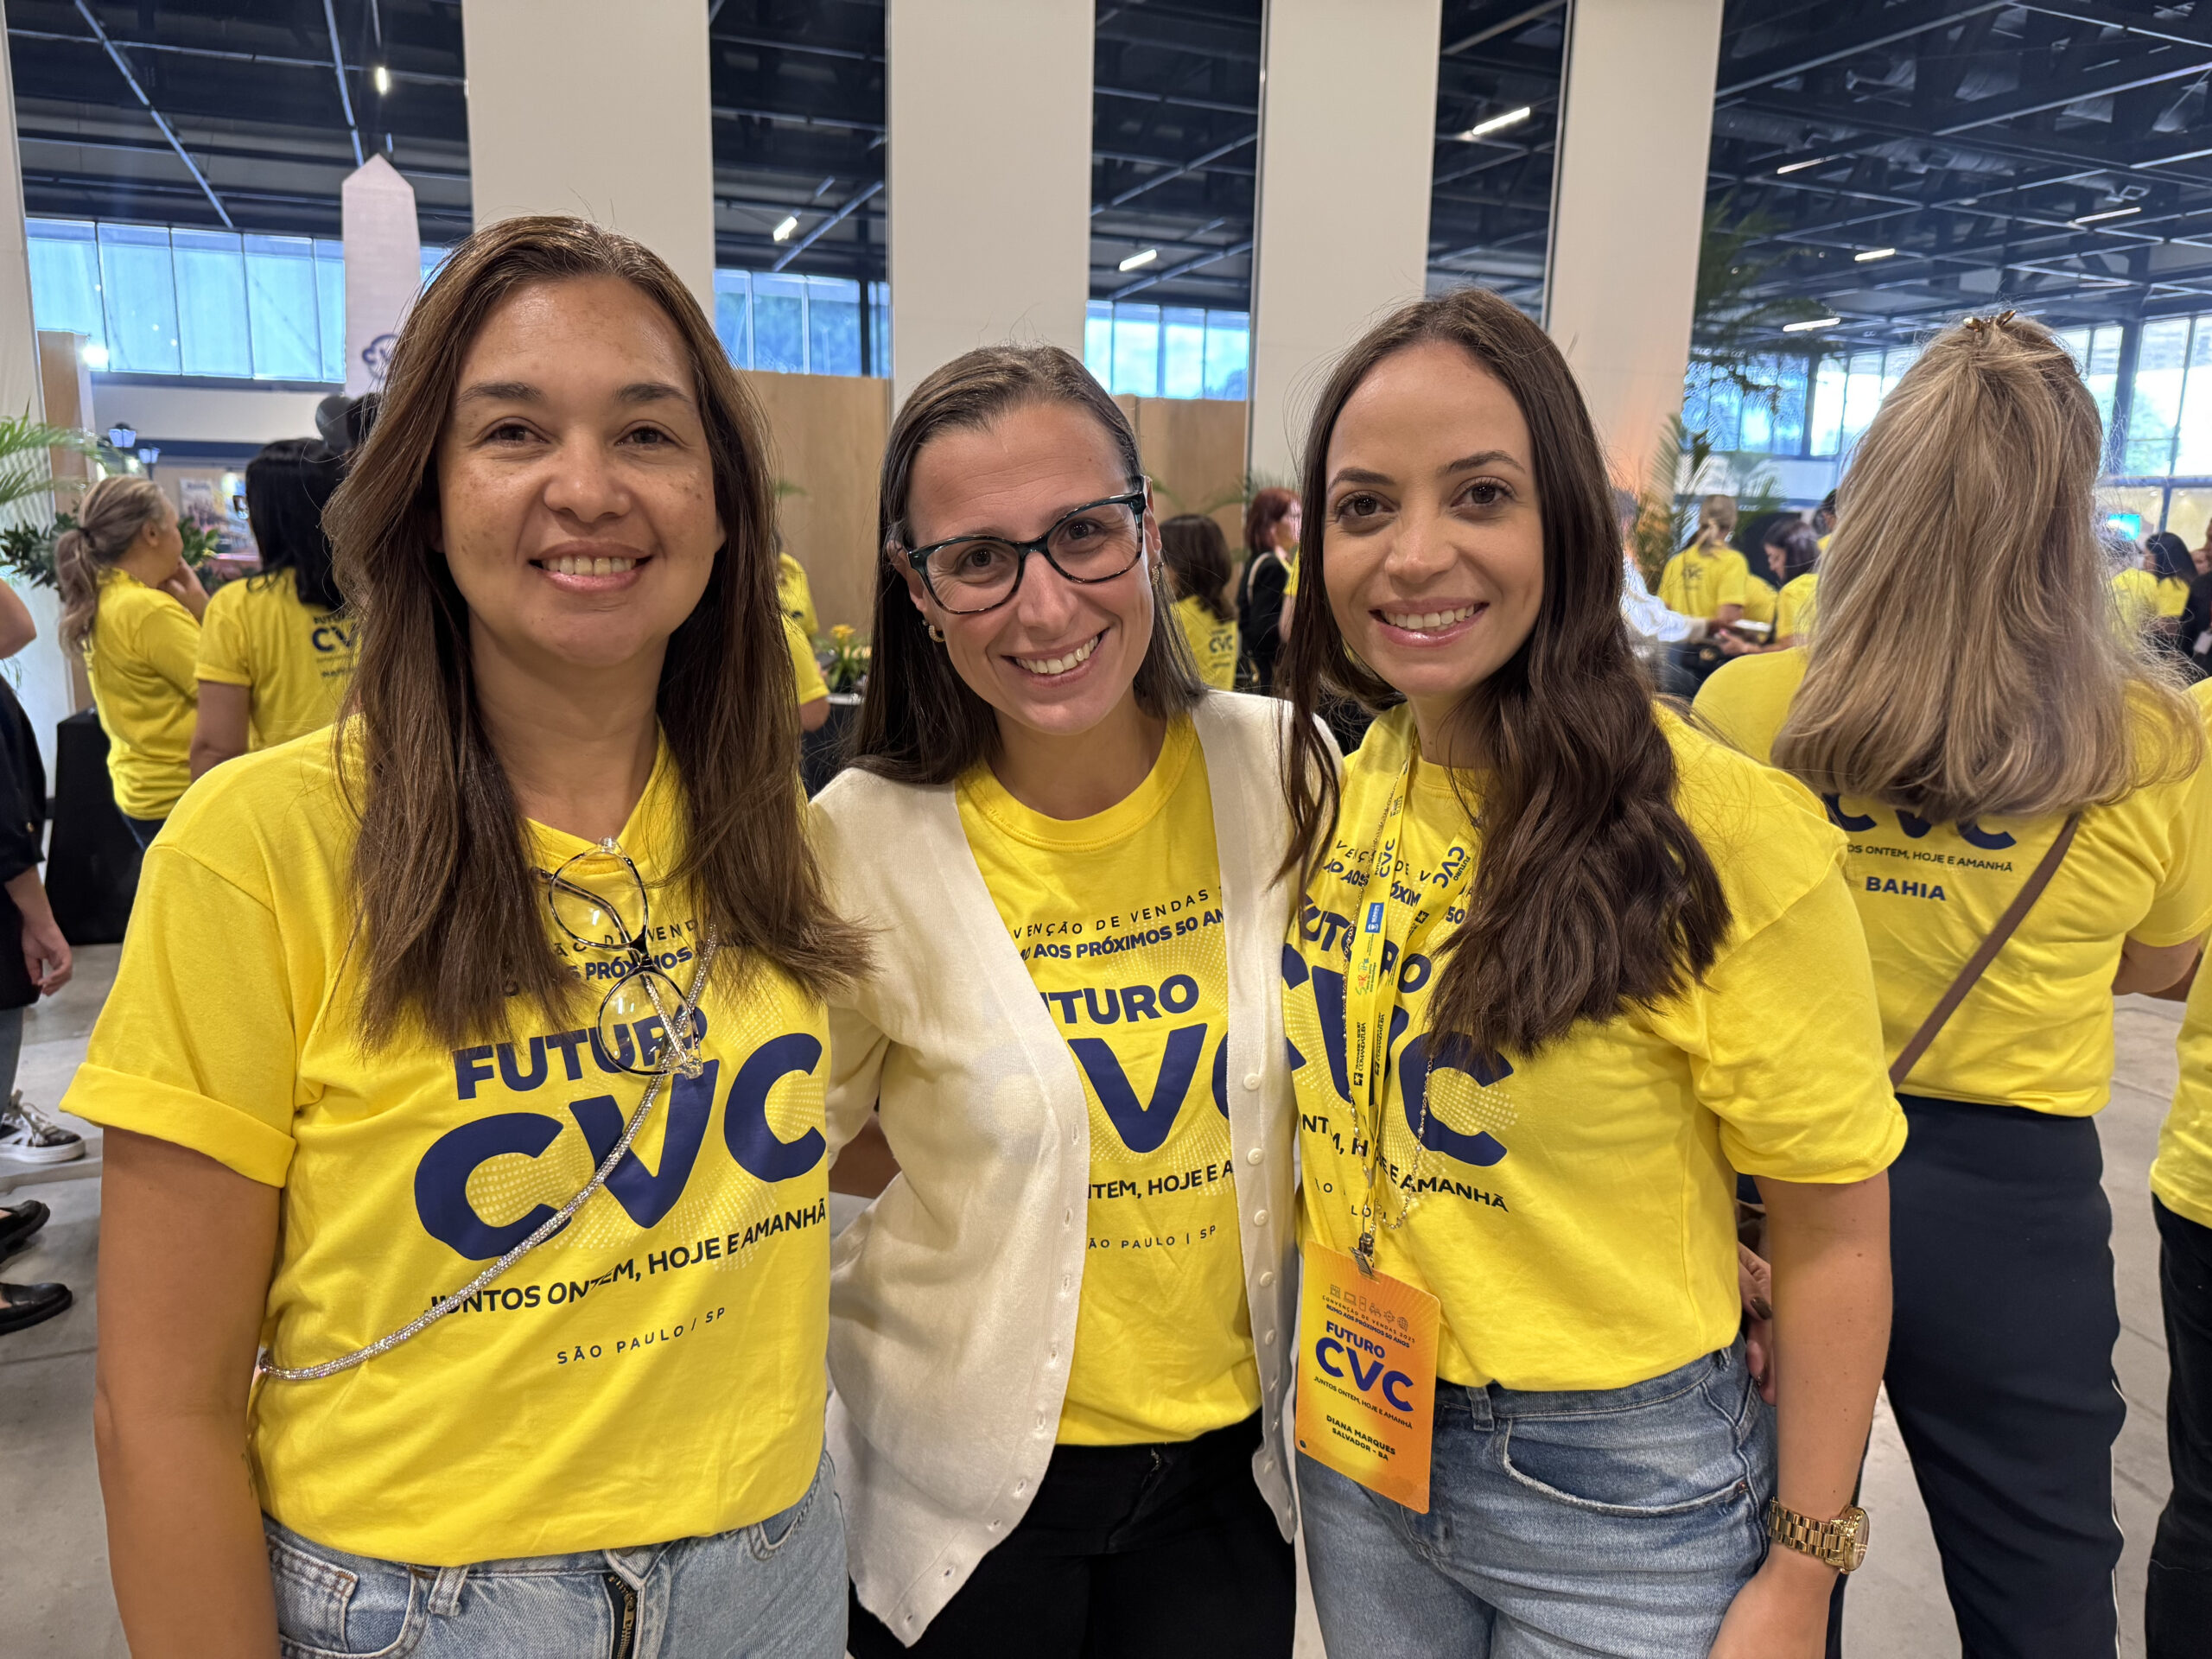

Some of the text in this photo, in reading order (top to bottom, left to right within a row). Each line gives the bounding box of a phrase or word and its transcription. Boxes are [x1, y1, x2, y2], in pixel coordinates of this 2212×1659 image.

[312, 627, 355, 652] CV
[1380, 838, 1395, 878] CVC
[1433, 846, 1465, 889] CVC
[1453, 855, 1471, 881] FUTURO
[1866, 845, 1910, 860] ONTEM,
[1913, 851, 1944, 864] HOJE
[1948, 856, 1955, 865] E
[1957, 857, 2012, 873] AMANHÃ
[1866, 876, 1946, 901] BAHIA
[648, 918, 698, 941] VEND
[1014, 921, 1083, 939] VENÇÃO
[1096, 916, 1120, 931] DE
[1130, 889, 1209, 923] VENDAS
[1446, 906, 1466, 925] 50
[1033, 943, 1071, 959] AOS
[1077, 925, 1173, 958] PRÓXIMOS
[1176, 917, 1198, 936] 50
[1040, 974, 1199, 1026] TURO
[415, 1033, 826, 1262] CVC
[1089, 1180, 1141, 1199] TEM,
[1148, 1169, 1202, 1196] HOJE
[1207, 1164, 1217, 1183] E
[1400, 1173, 1509, 1213] AMANHÃ
[648, 1236, 721, 1274] HOJE
[728, 1232, 740, 1255] E
[741, 1198, 826, 1249] AMANHÃ
[1089, 1237, 1110, 1249] ÃO
[1121, 1236, 1175, 1249] PAULO
[1200, 1224, 1216, 1239] SP
[556, 1345, 602, 1364] SÃO
[616, 1325, 683, 1353] PAULO
[705, 1307, 725, 1323] SP
[1326, 1304, 1343, 1315] RUMO
[1343, 1313, 1355, 1321] AOS
[1393, 1337, 1409, 1348] ANOS
[1326, 1320, 1385, 1359] FUTURO
[1372, 1319, 1396, 1335] VENDAS
[1316, 1337, 1414, 1412] CVC
[1313, 1376, 1338, 1392] JUNTOS
[1338, 1388, 1360, 1405] ONTEM,
[1362, 1400, 1378, 1414] HOJE
[1383, 1411, 1413, 1430] AMANHÃ
[1326, 1414, 1395, 1455] DIANA MARQUES
[1332, 1427, 1370, 1452] SALVADOR
[1378, 1451, 1389, 1461] BA
